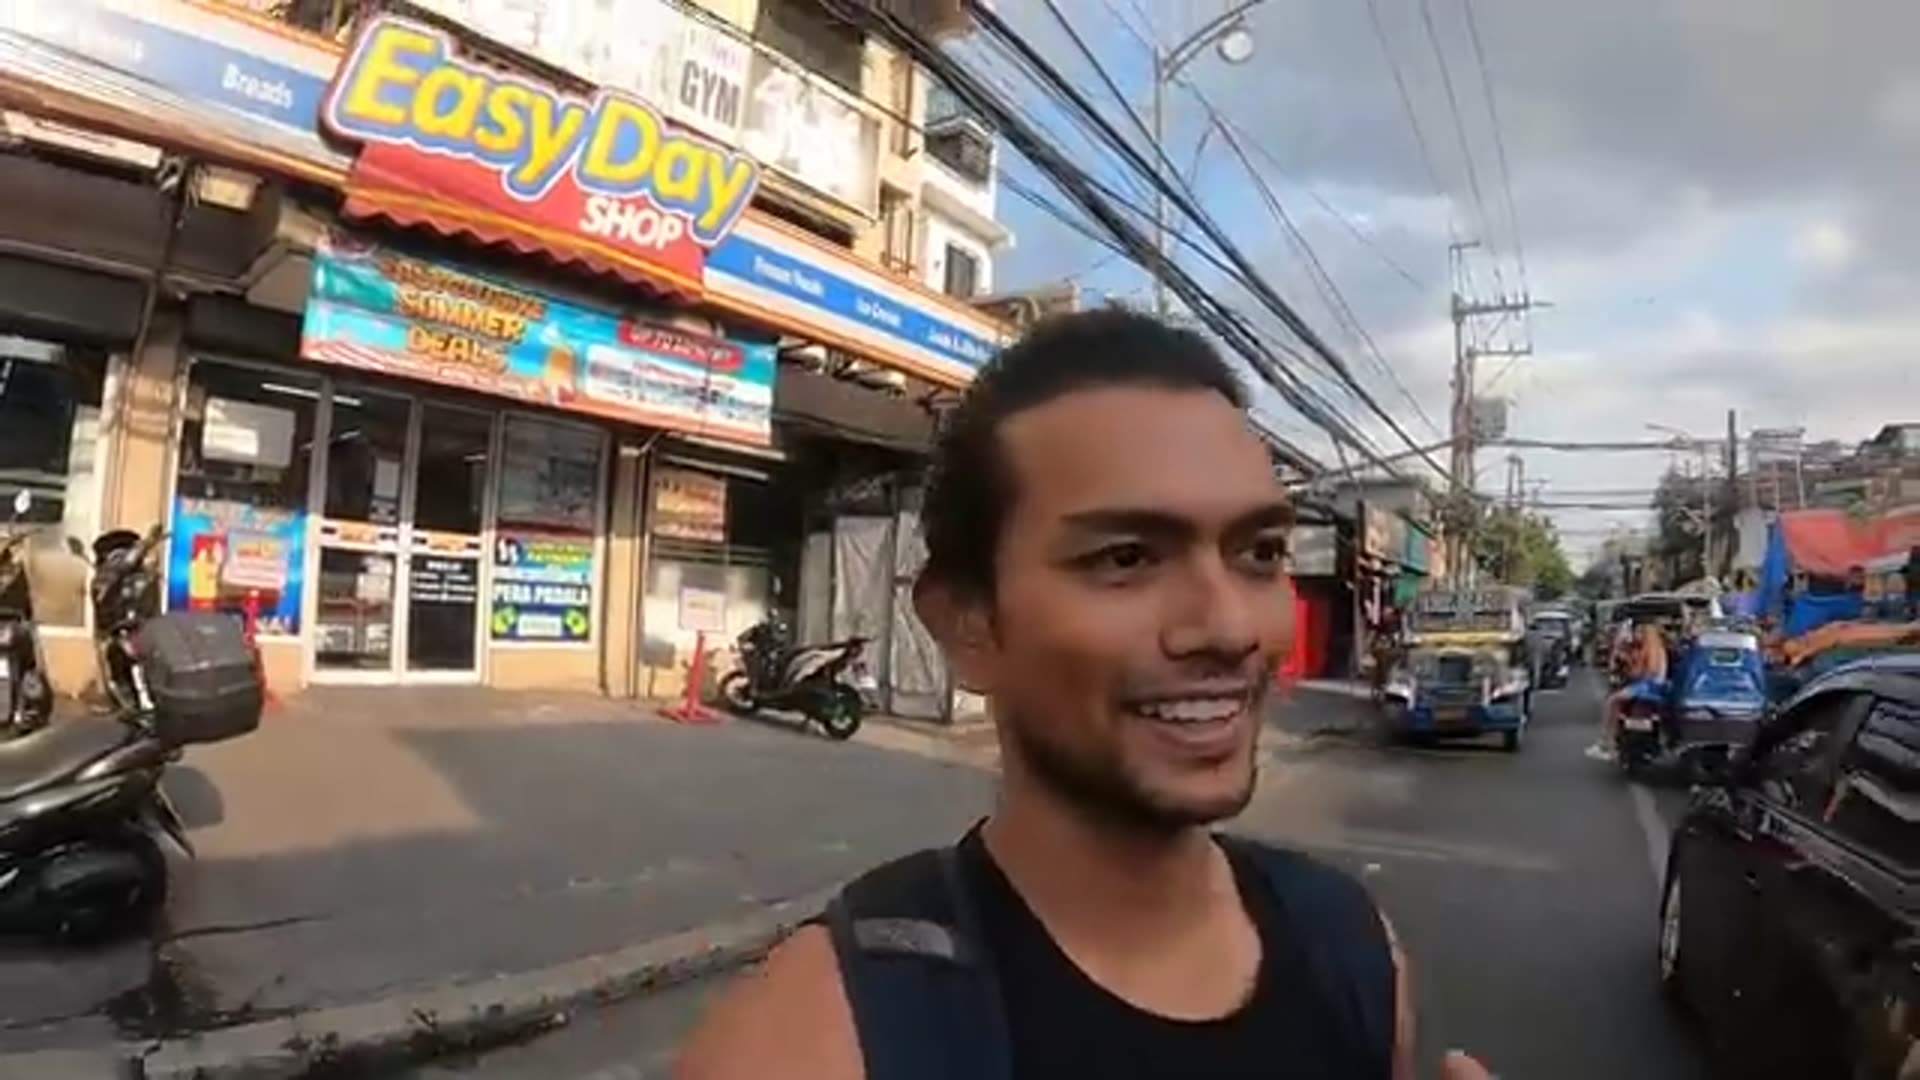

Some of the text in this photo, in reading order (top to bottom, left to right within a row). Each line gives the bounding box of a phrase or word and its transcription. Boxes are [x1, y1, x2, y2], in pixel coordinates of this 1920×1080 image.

[222, 63, 294, 109] Breads
[679, 60, 743, 128] GYM
[345, 26, 752, 231] Easy Day
[579, 198, 682, 250] SHOP
[400, 290, 527, 343] SUMMER
